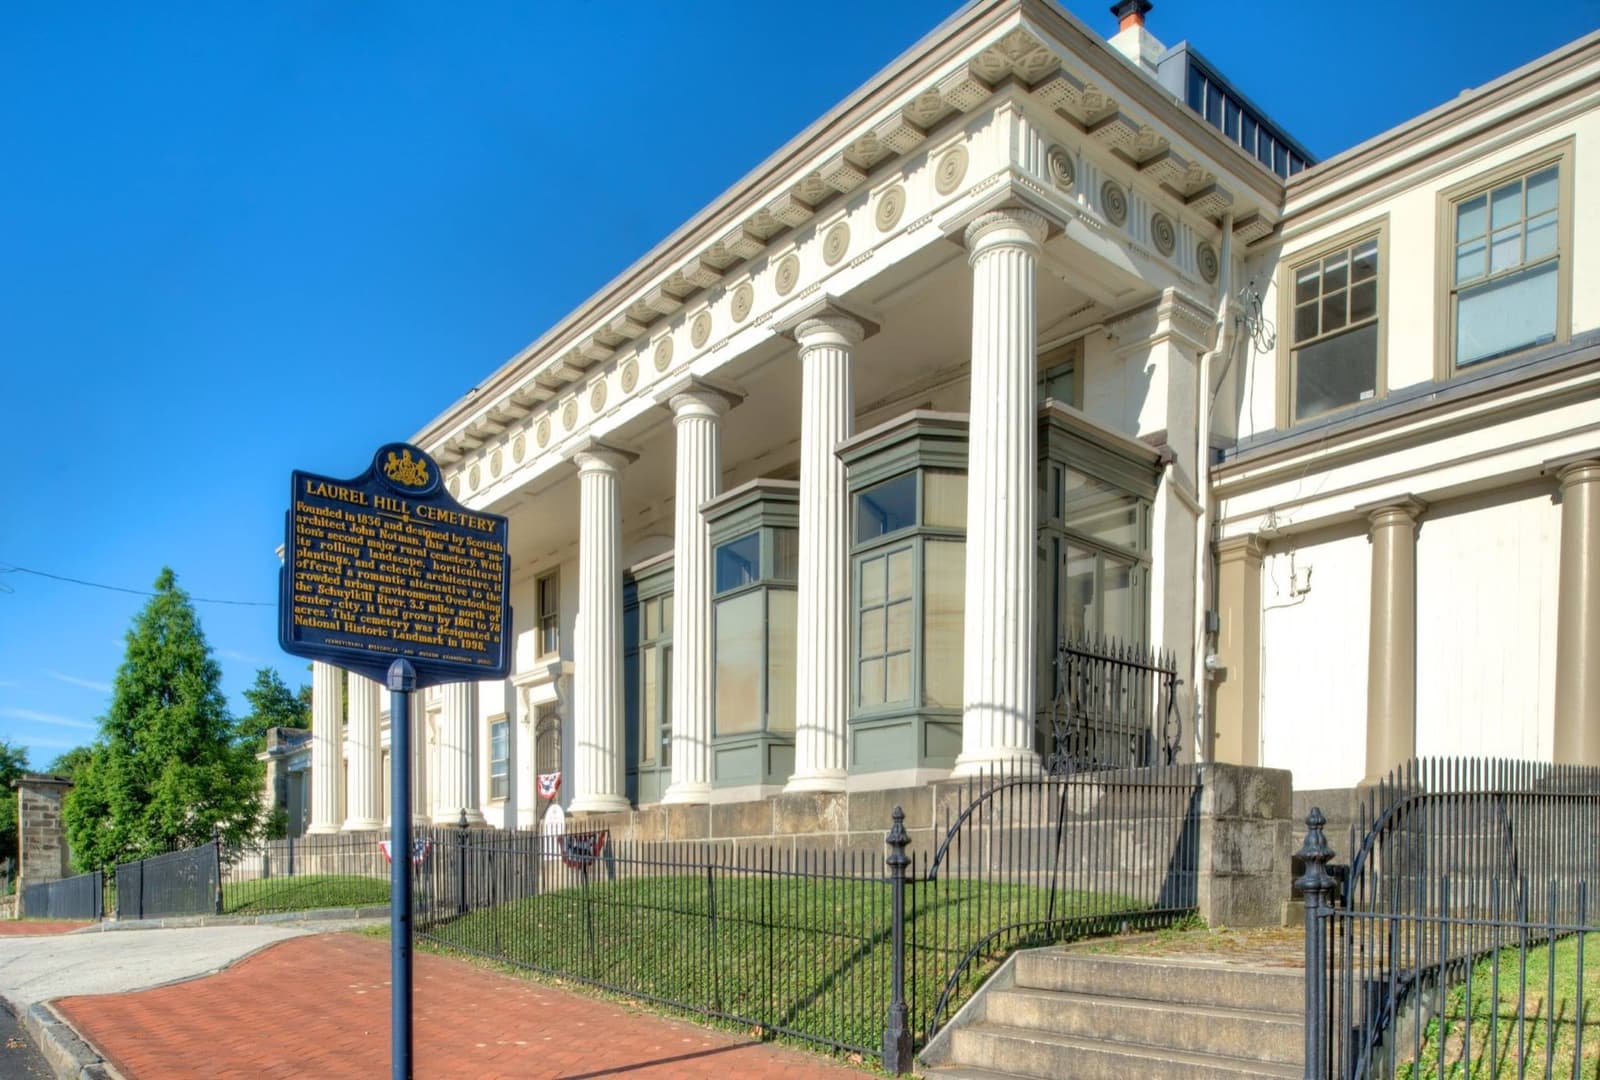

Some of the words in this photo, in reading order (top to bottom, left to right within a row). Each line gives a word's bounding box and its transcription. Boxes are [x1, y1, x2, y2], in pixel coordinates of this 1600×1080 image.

[306, 480, 368, 506] LAUREL
[374, 495, 410, 514] HILL
[416, 505, 496, 531] CEMETERY
[296, 501, 342, 518] Founded
[345, 512, 355, 522] in
[384, 521, 402, 531] and
[406, 524, 449, 541] designed
[452, 533, 464, 546] by
[466, 537, 502, 552] Scottish
[296, 515, 346, 530] architect
[350, 523, 375, 536] John
[425, 538, 443, 549] this
[449, 544, 466, 554] was
[470, 549, 485, 558] the
[296, 536, 311, 547] its
[320, 542, 360, 557] rolling
[433, 560, 501, 581] horticultural
[328, 532, 363, 545] second
[368, 540, 396, 552] major
[400, 546, 426, 557] rural
[480, 560, 502, 571] With
[296, 560, 342, 574] offered
[358, 571, 405, 585] romantic
[410, 579, 467, 596] alternative
[472, 590, 482, 598] to
[486, 592, 500, 601] the
[296, 572, 340, 585] crowded
[344, 579, 375, 591] urban
[445, 596, 500, 615] Overlooking
[355, 558, 374, 569] and
[380, 565, 421, 577] eclectic
[495, 583, 501, 591] it
[295, 582, 312, 592] the
[318, 585, 372, 602] Schuylkill
[429, 605, 455, 615] miles
[459, 610, 486, 620] north
[367, 605, 375, 613] it
[379, 606, 398, 617] had
[402, 612, 434, 622] grown
[438, 615, 450, 626] by
[454, 617, 474, 628] 1861
[477, 621, 486, 630] to
[489, 623, 500, 632] 78
[295, 615, 340, 631] National
[344, 622, 388, 637] Historic
[393, 630, 443, 645] Landmark
[448, 638, 457, 646] in
[331, 608, 356, 622] This
[360, 615, 409, 631] cemetery
[415, 623, 432, 632] was
[437, 626, 490, 641] designated
